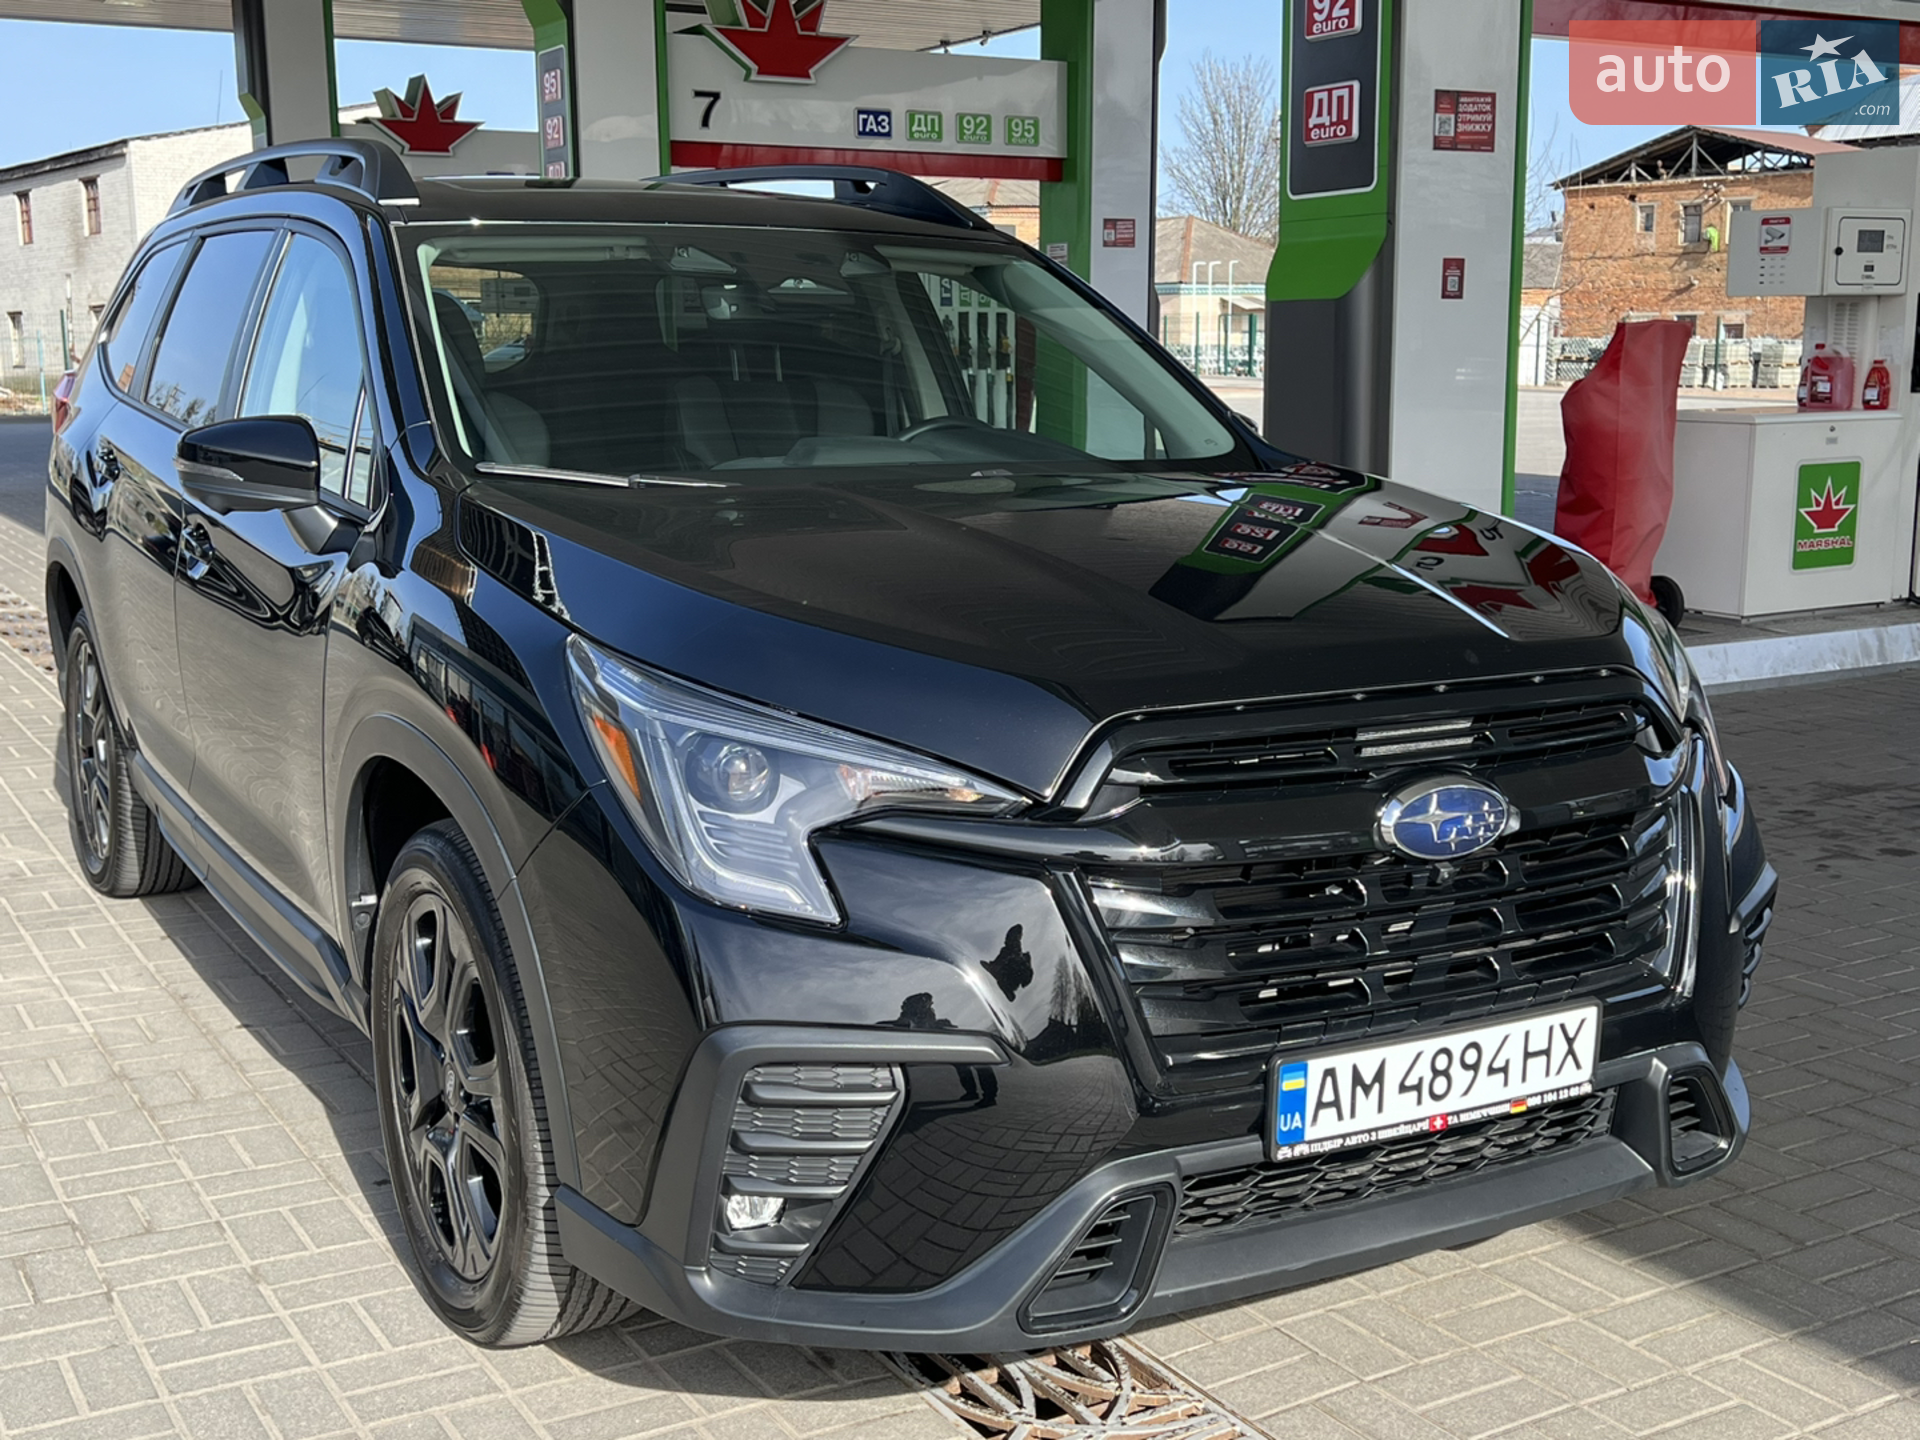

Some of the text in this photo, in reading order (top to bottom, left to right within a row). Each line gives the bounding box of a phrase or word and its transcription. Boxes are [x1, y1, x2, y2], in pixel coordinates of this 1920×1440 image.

[1312, 17, 1349, 34] euro
[543, 72, 557, 94] 95
[692, 89, 721, 130] 7
[1308, 88, 1350, 128] ДП
[546, 119, 559, 140] 92
[858, 114, 890, 133] ГАЗ
[911, 113, 940, 132] ДП
[962, 116, 988, 135] 92
[1011, 118, 1036, 137] 95
[1310, 124, 1347, 140] euro
[1456, 123, 1493, 132] ЗНИЖКУ
[913, 131, 939, 139] euro
[963, 134, 988, 142] euro
[1011, 136, 1035, 144] euro
[1796, 535, 1853, 551] MARSHAL
[1310, 1017, 1588, 1127] AM 4894 HX
[1280, 1111, 1302, 1131] UA
[1344, 1133, 1369, 1146] АВТО
